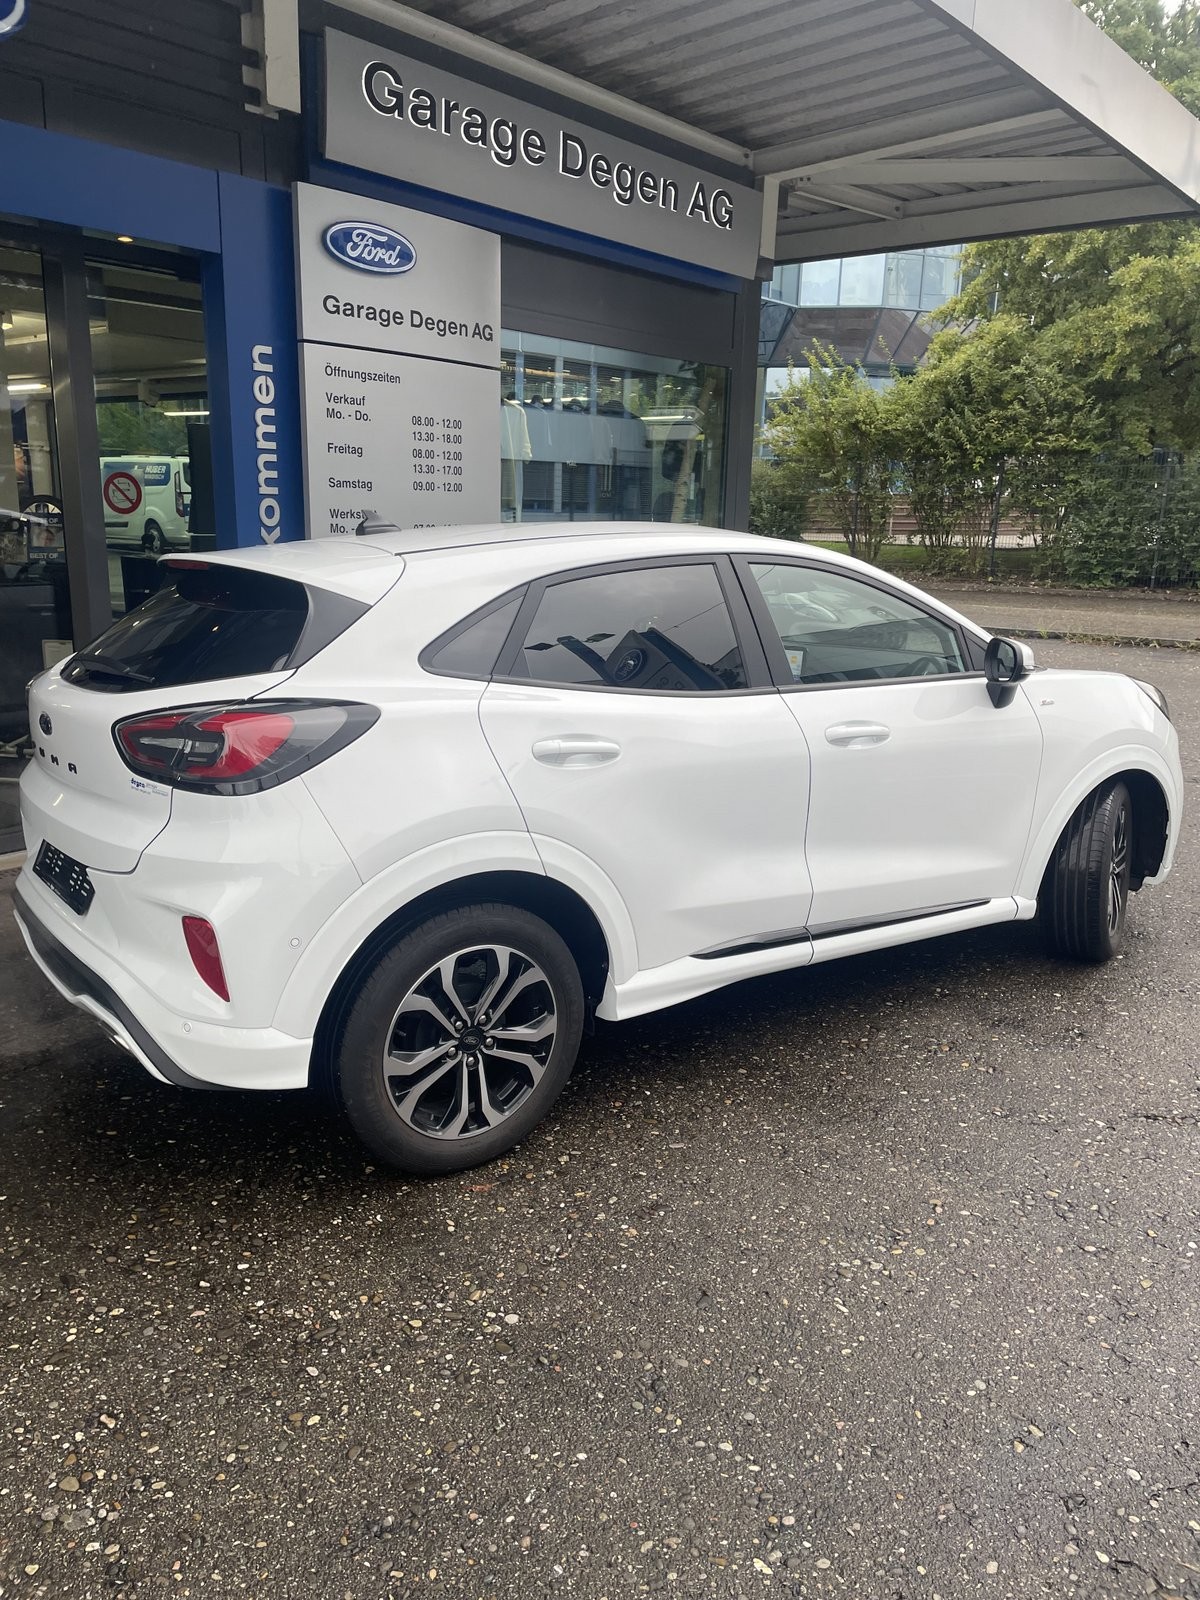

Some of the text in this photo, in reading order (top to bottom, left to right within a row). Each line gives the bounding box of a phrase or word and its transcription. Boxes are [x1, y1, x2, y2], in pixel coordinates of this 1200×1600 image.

[361, 60, 734, 230] Garage Degen AG
[346, 228, 401, 266] Ford
[322, 294, 494, 342] Garage Degen AG
[324, 362, 401, 384] Öffnungszeiten
[325, 392, 365, 406] Verkauf
[326, 408, 345, 420] Mo.
[354, 410, 372, 422] Do.
[411, 415, 435, 427] 08.00
[442, 418, 462, 430] 12.00
[412, 431, 435, 443] 13.30
[442, 434, 462, 445] 18.00
[327, 443, 363, 457] Freitag
[412, 448, 435, 460] 08.00
[442, 451, 462, 462] 12.00
[412, 463, 435, 475] 13.30
[442, 466, 463, 477] 17.00
[328, 477, 373, 492] Samstag
[412, 480, 435, 492] 09.00
[442, 483, 463, 493] 12.00
[329, 523, 349, 534] Mo.
